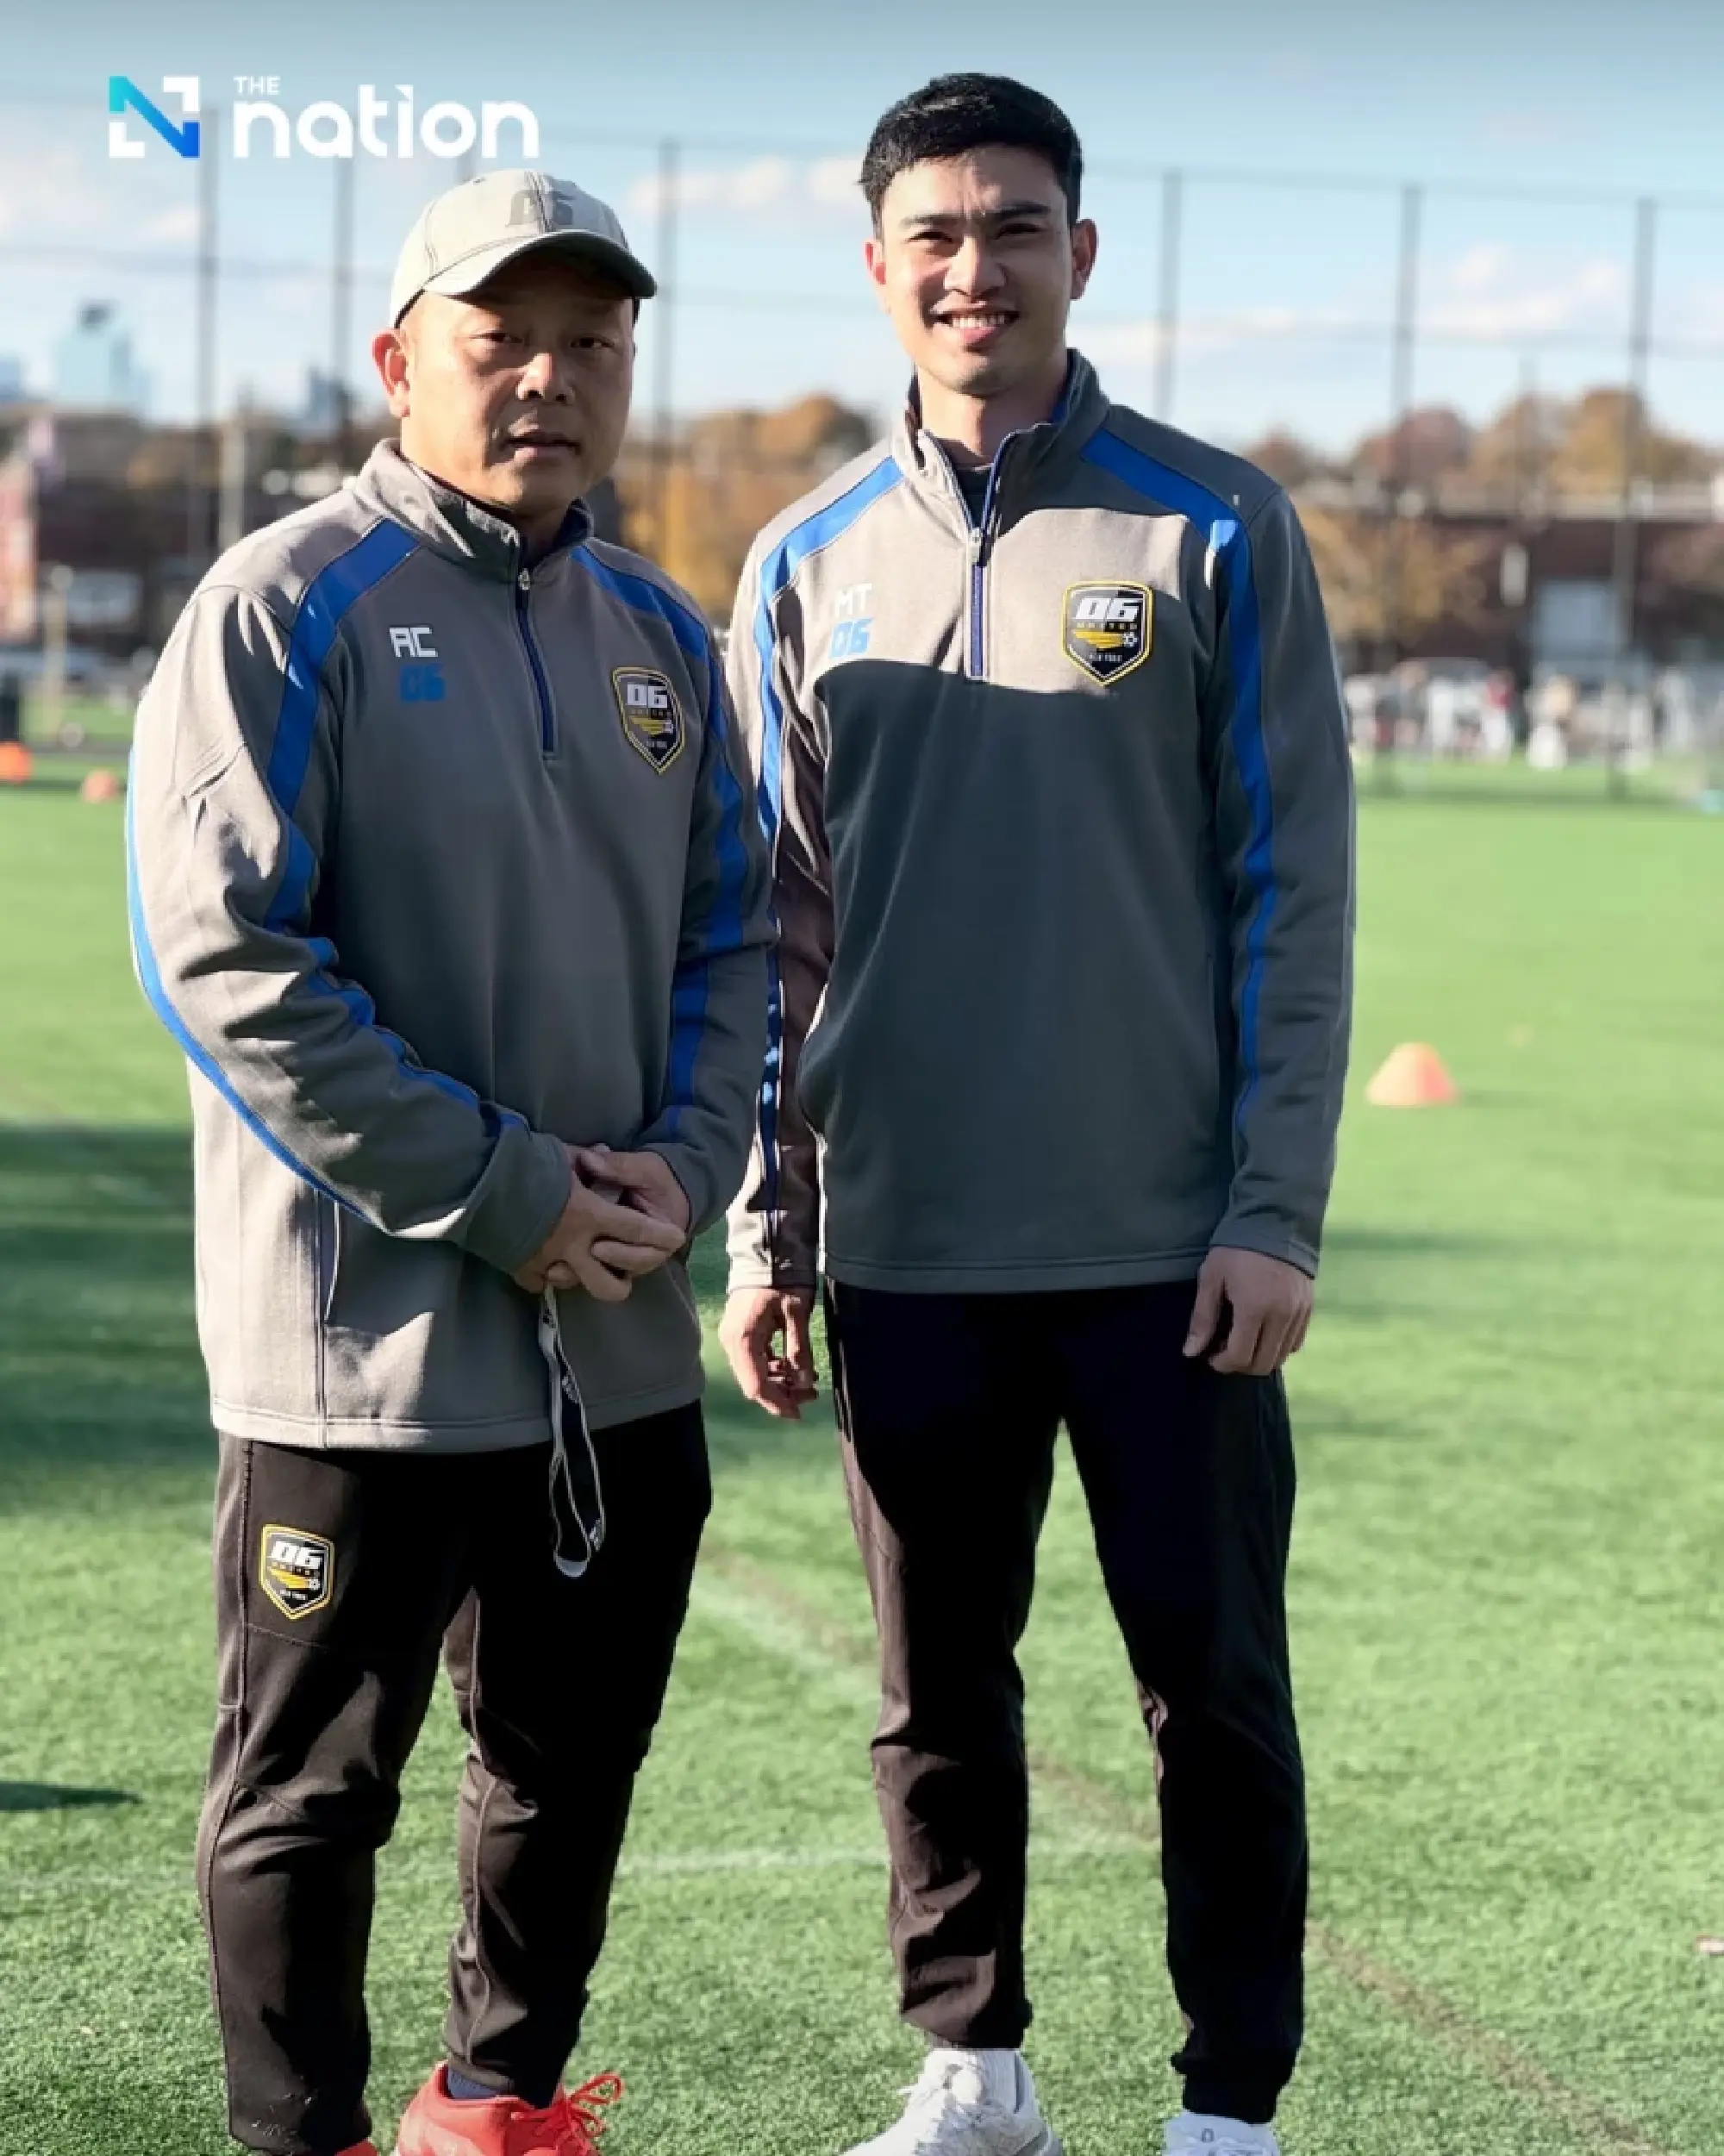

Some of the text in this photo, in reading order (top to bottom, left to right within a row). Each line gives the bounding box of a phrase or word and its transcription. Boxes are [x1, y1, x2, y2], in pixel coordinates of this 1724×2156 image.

[834, 583, 872, 618] MT
[1074, 597, 1143, 622] 06
[390, 627, 438, 657] AC
[829, 618, 871, 658] 06
[626, 684, 668, 708] 06
[270, 1540, 327, 1569] 06
